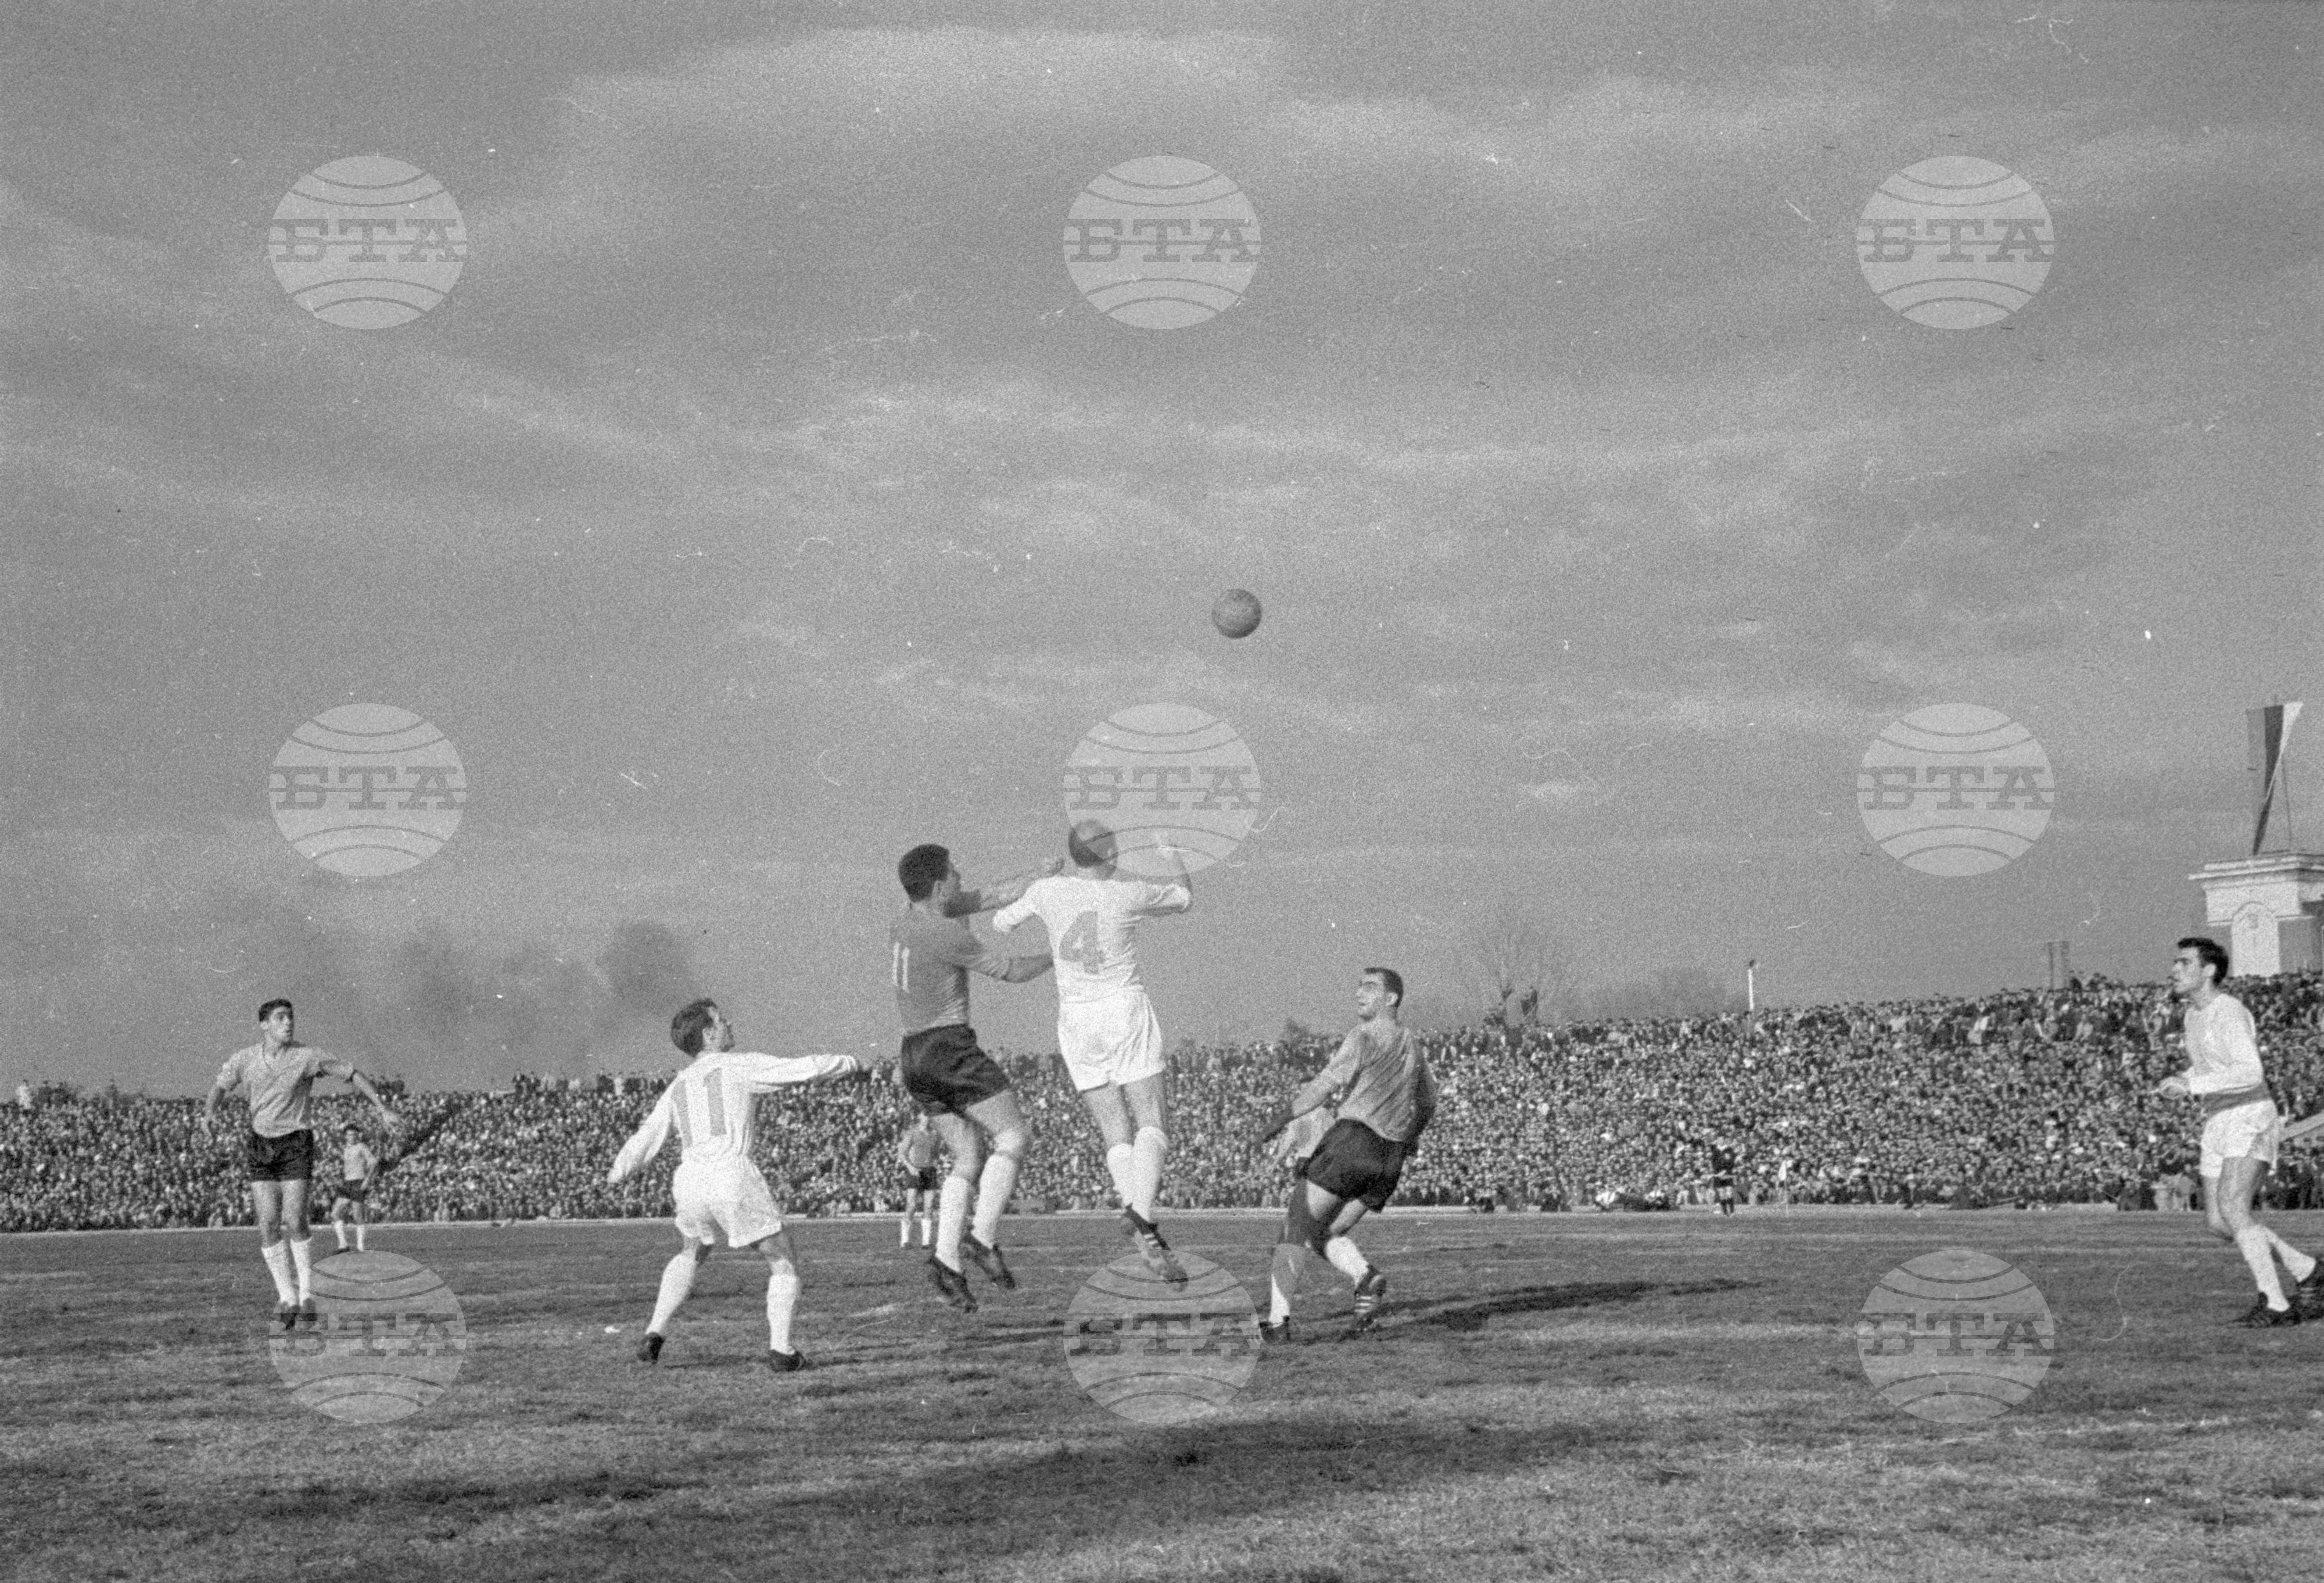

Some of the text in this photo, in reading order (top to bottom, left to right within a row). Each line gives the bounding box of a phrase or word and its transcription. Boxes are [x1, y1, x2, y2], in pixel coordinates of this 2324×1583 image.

[892, 942, 911, 994] 11
[1058, 910, 1106, 975] 4
[670, 1067, 727, 1148] 11
